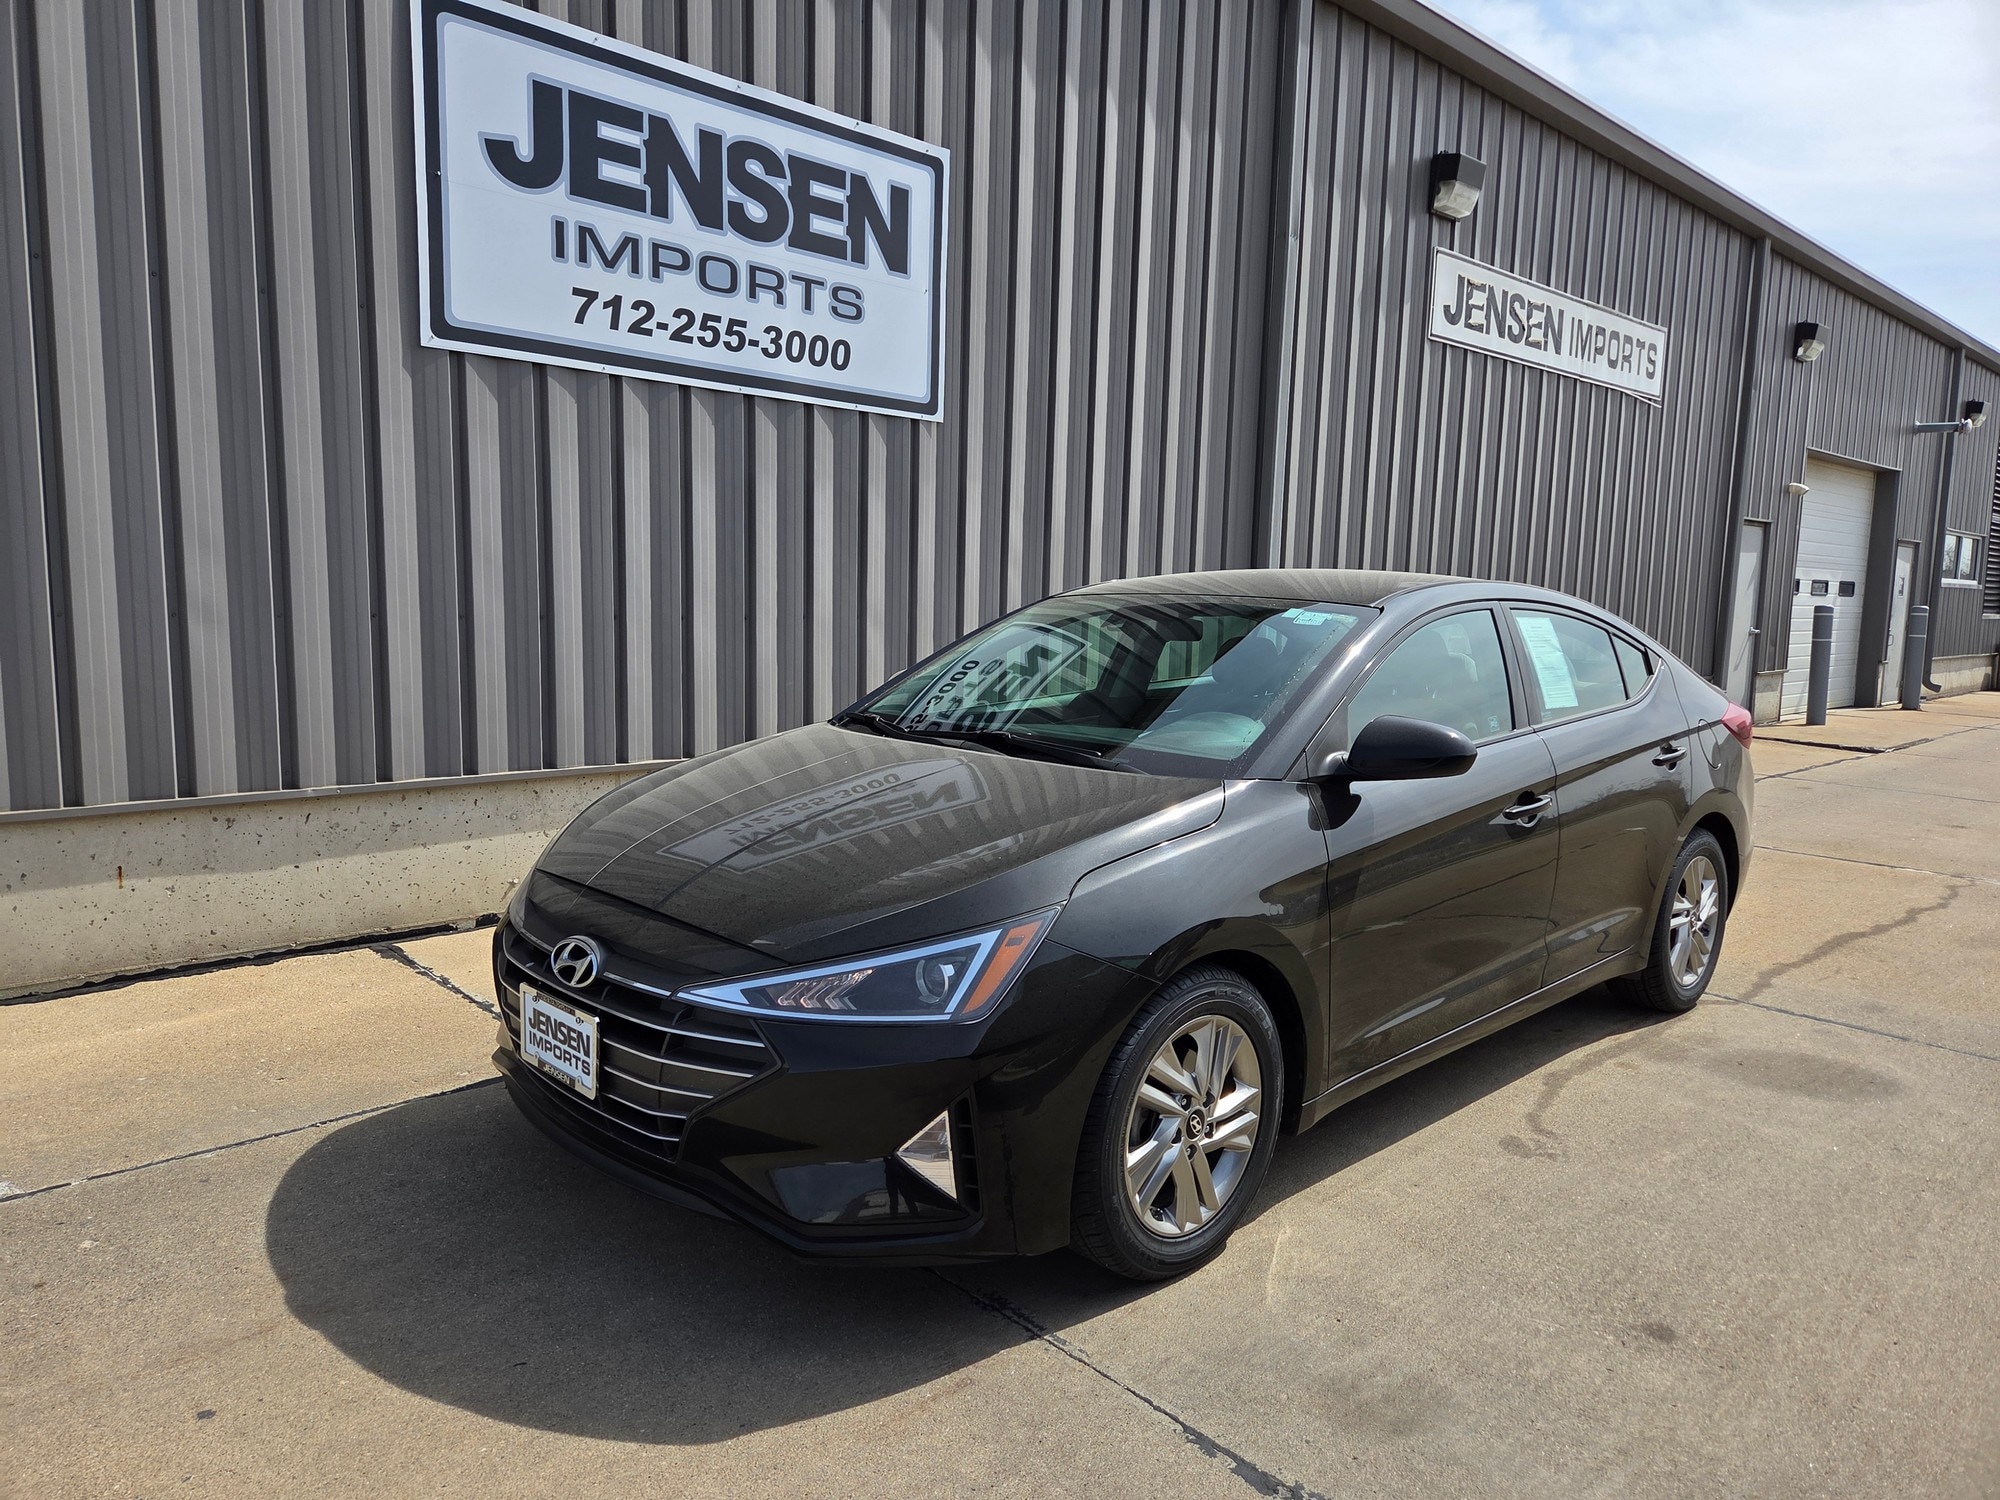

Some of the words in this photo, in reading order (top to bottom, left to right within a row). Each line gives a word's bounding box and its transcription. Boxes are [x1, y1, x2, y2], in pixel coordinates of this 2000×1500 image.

[480, 75, 911, 278] JENSEN
[552, 217, 865, 323] IMPORTS
[570, 286, 852, 372] 712-255-3000
[1443, 273, 1564, 356] JENSEN
[1568, 316, 1658, 380] IMPORTS
[529, 1007, 591, 1058] JENSEN
[529, 1030, 591, 1076] IMPORTS
[543, 1064, 570, 1085] JENSEN
